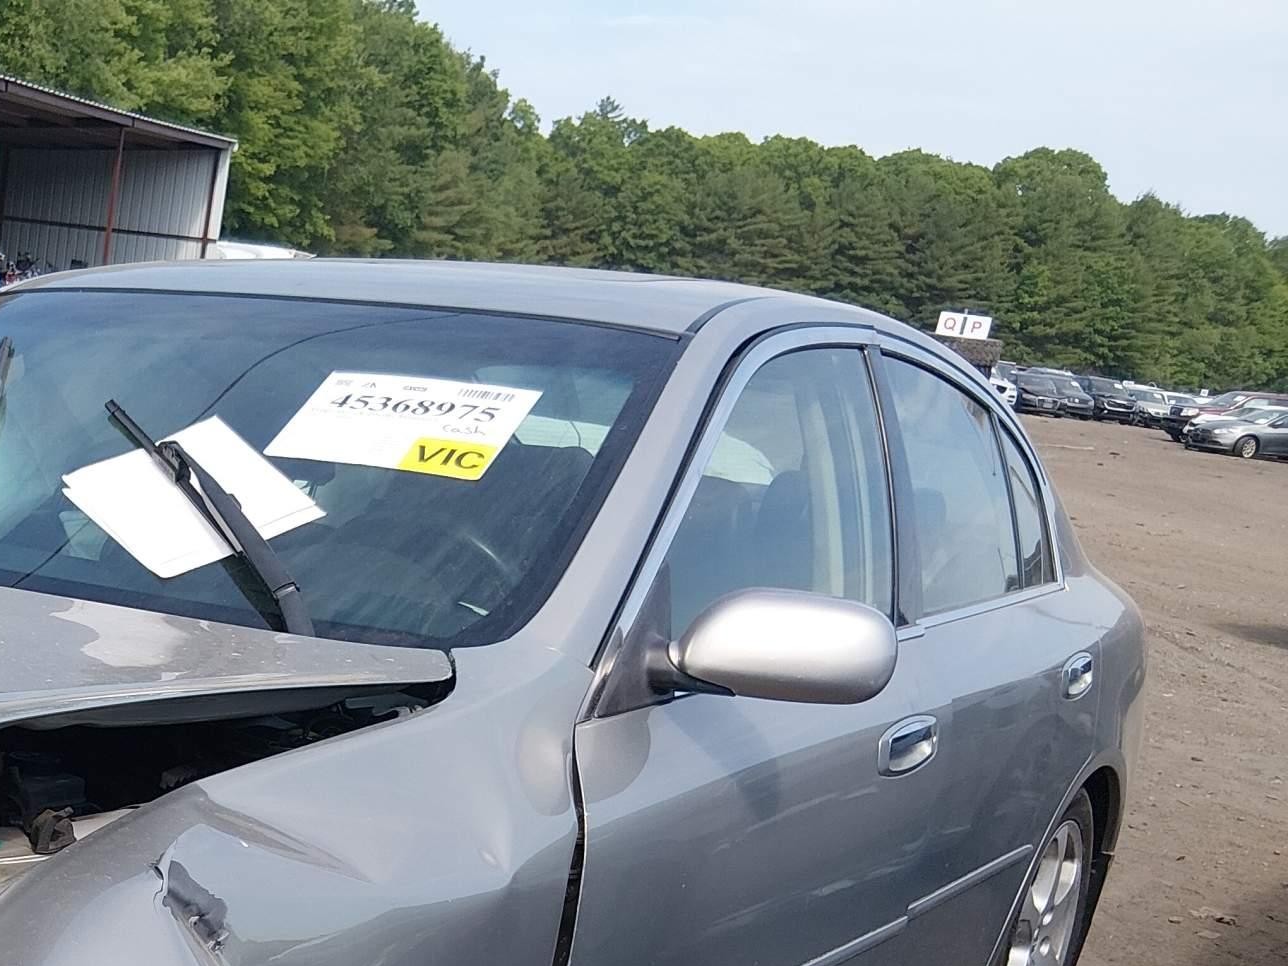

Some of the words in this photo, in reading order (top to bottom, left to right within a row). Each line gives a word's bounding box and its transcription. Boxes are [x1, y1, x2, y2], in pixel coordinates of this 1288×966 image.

[944, 317, 956, 331] Q
[971, 321, 982, 333] P
[329, 393, 500, 423] 45368975
[416, 444, 485, 470] VIC
